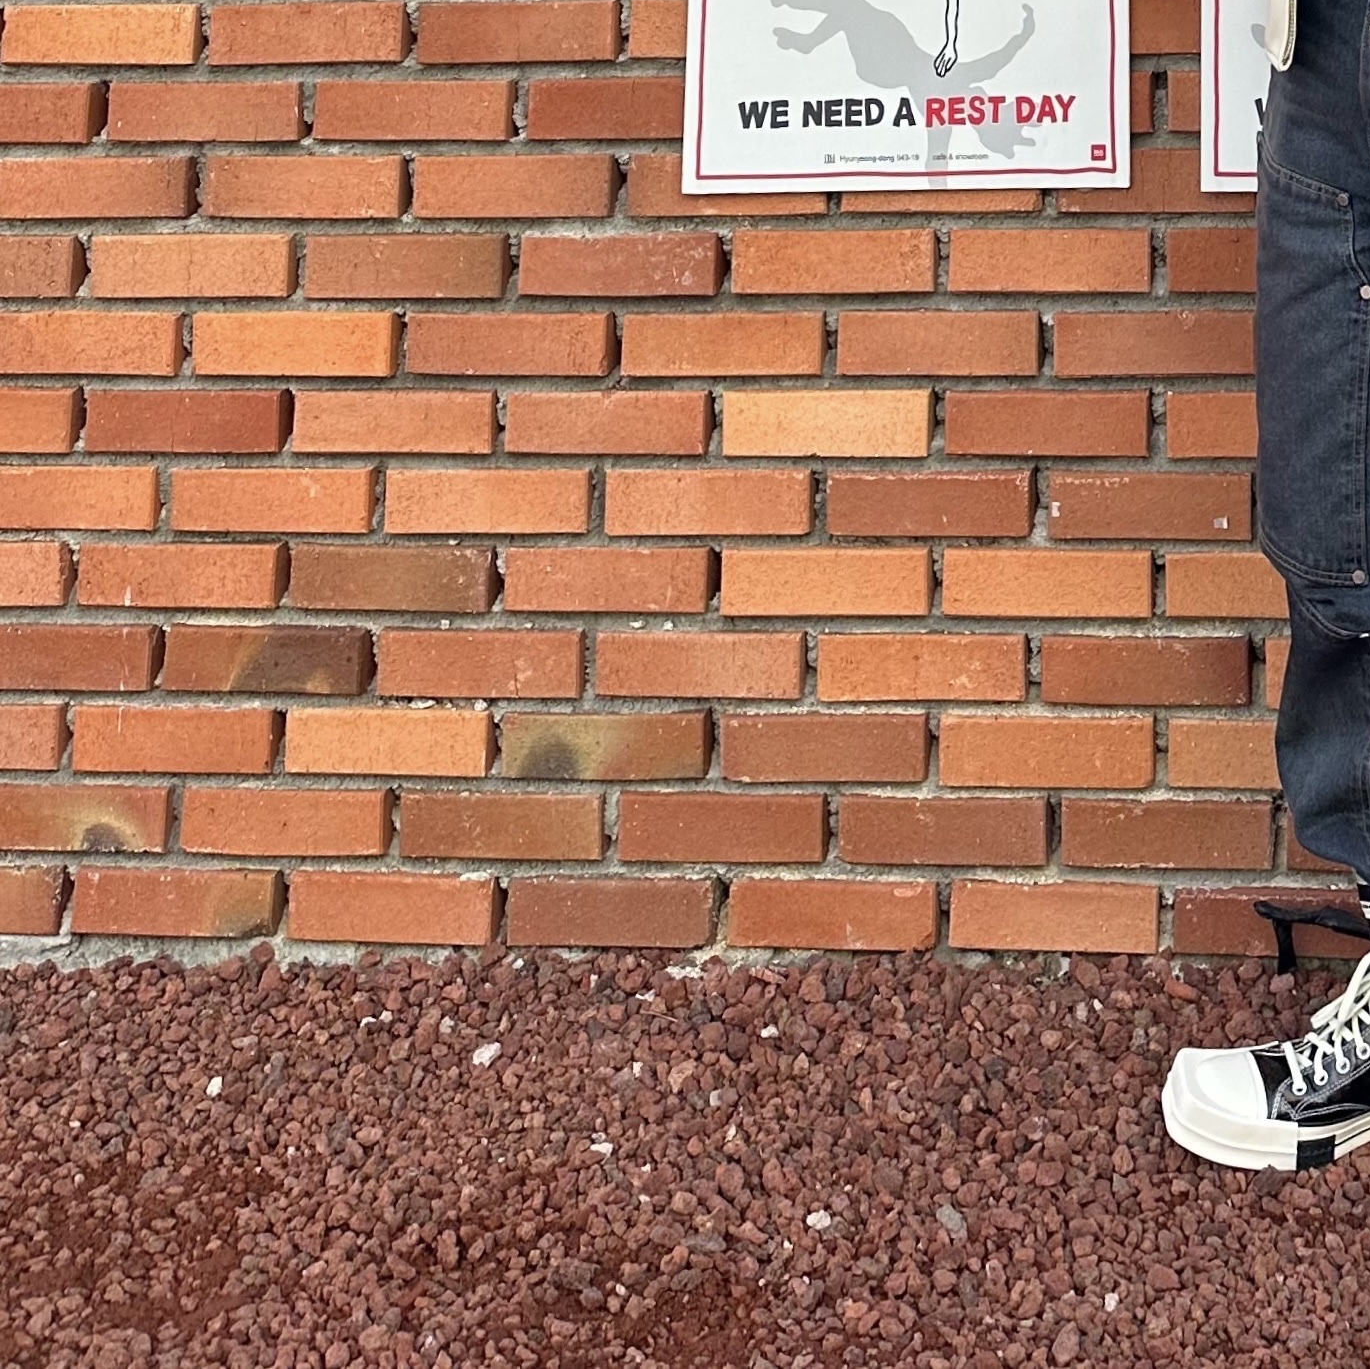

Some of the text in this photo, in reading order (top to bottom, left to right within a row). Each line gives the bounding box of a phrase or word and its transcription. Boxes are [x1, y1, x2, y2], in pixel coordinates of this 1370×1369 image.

[738, 95, 1075, 128] WE NEED A REST DAY
